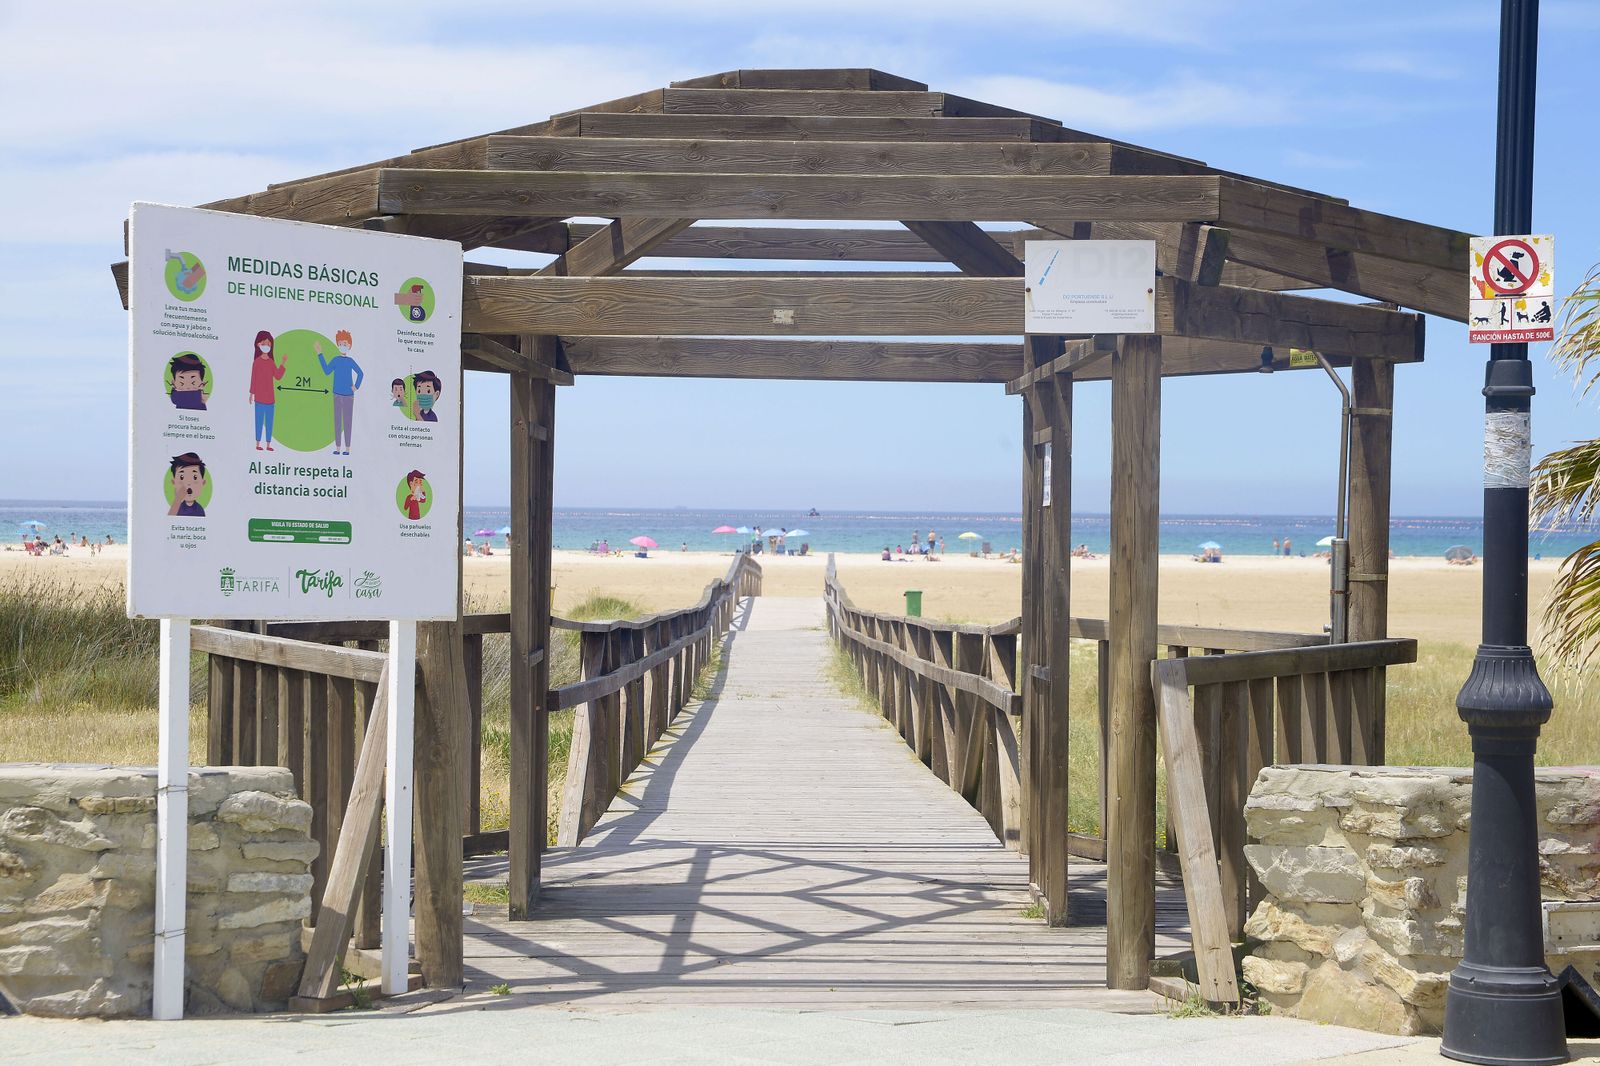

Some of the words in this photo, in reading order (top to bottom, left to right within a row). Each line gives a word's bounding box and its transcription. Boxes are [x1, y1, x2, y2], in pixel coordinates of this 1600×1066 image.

[228, 256, 303, 279] MEDIDAS
[308, 263, 379, 287] BÁSICAS
[227, 281, 246, 295] DE
[250, 284, 305, 301] HIGIENE
[309, 290, 379, 309] PERSONAL
[164, 312, 208, 322] frecuentemente
[172, 322, 185, 330] agua
[1472, 332, 1502, 341] SANCIÓN
[295, 376, 311, 387] 2M
[163, 431, 185, 439] siempre
[248, 461, 261, 474] Al
[264, 462, 291, 475] salir
[294, 466, 340, 480] respeta
[342, 466, 353, 478] la
[254, 482, 310, 497] distancia
[312, 485, 348, 498] social
[236, 580, 280, 593] TARIFA
[295, 569, 344, 598] Tarifa
[355, 587, 383, 599] casa
